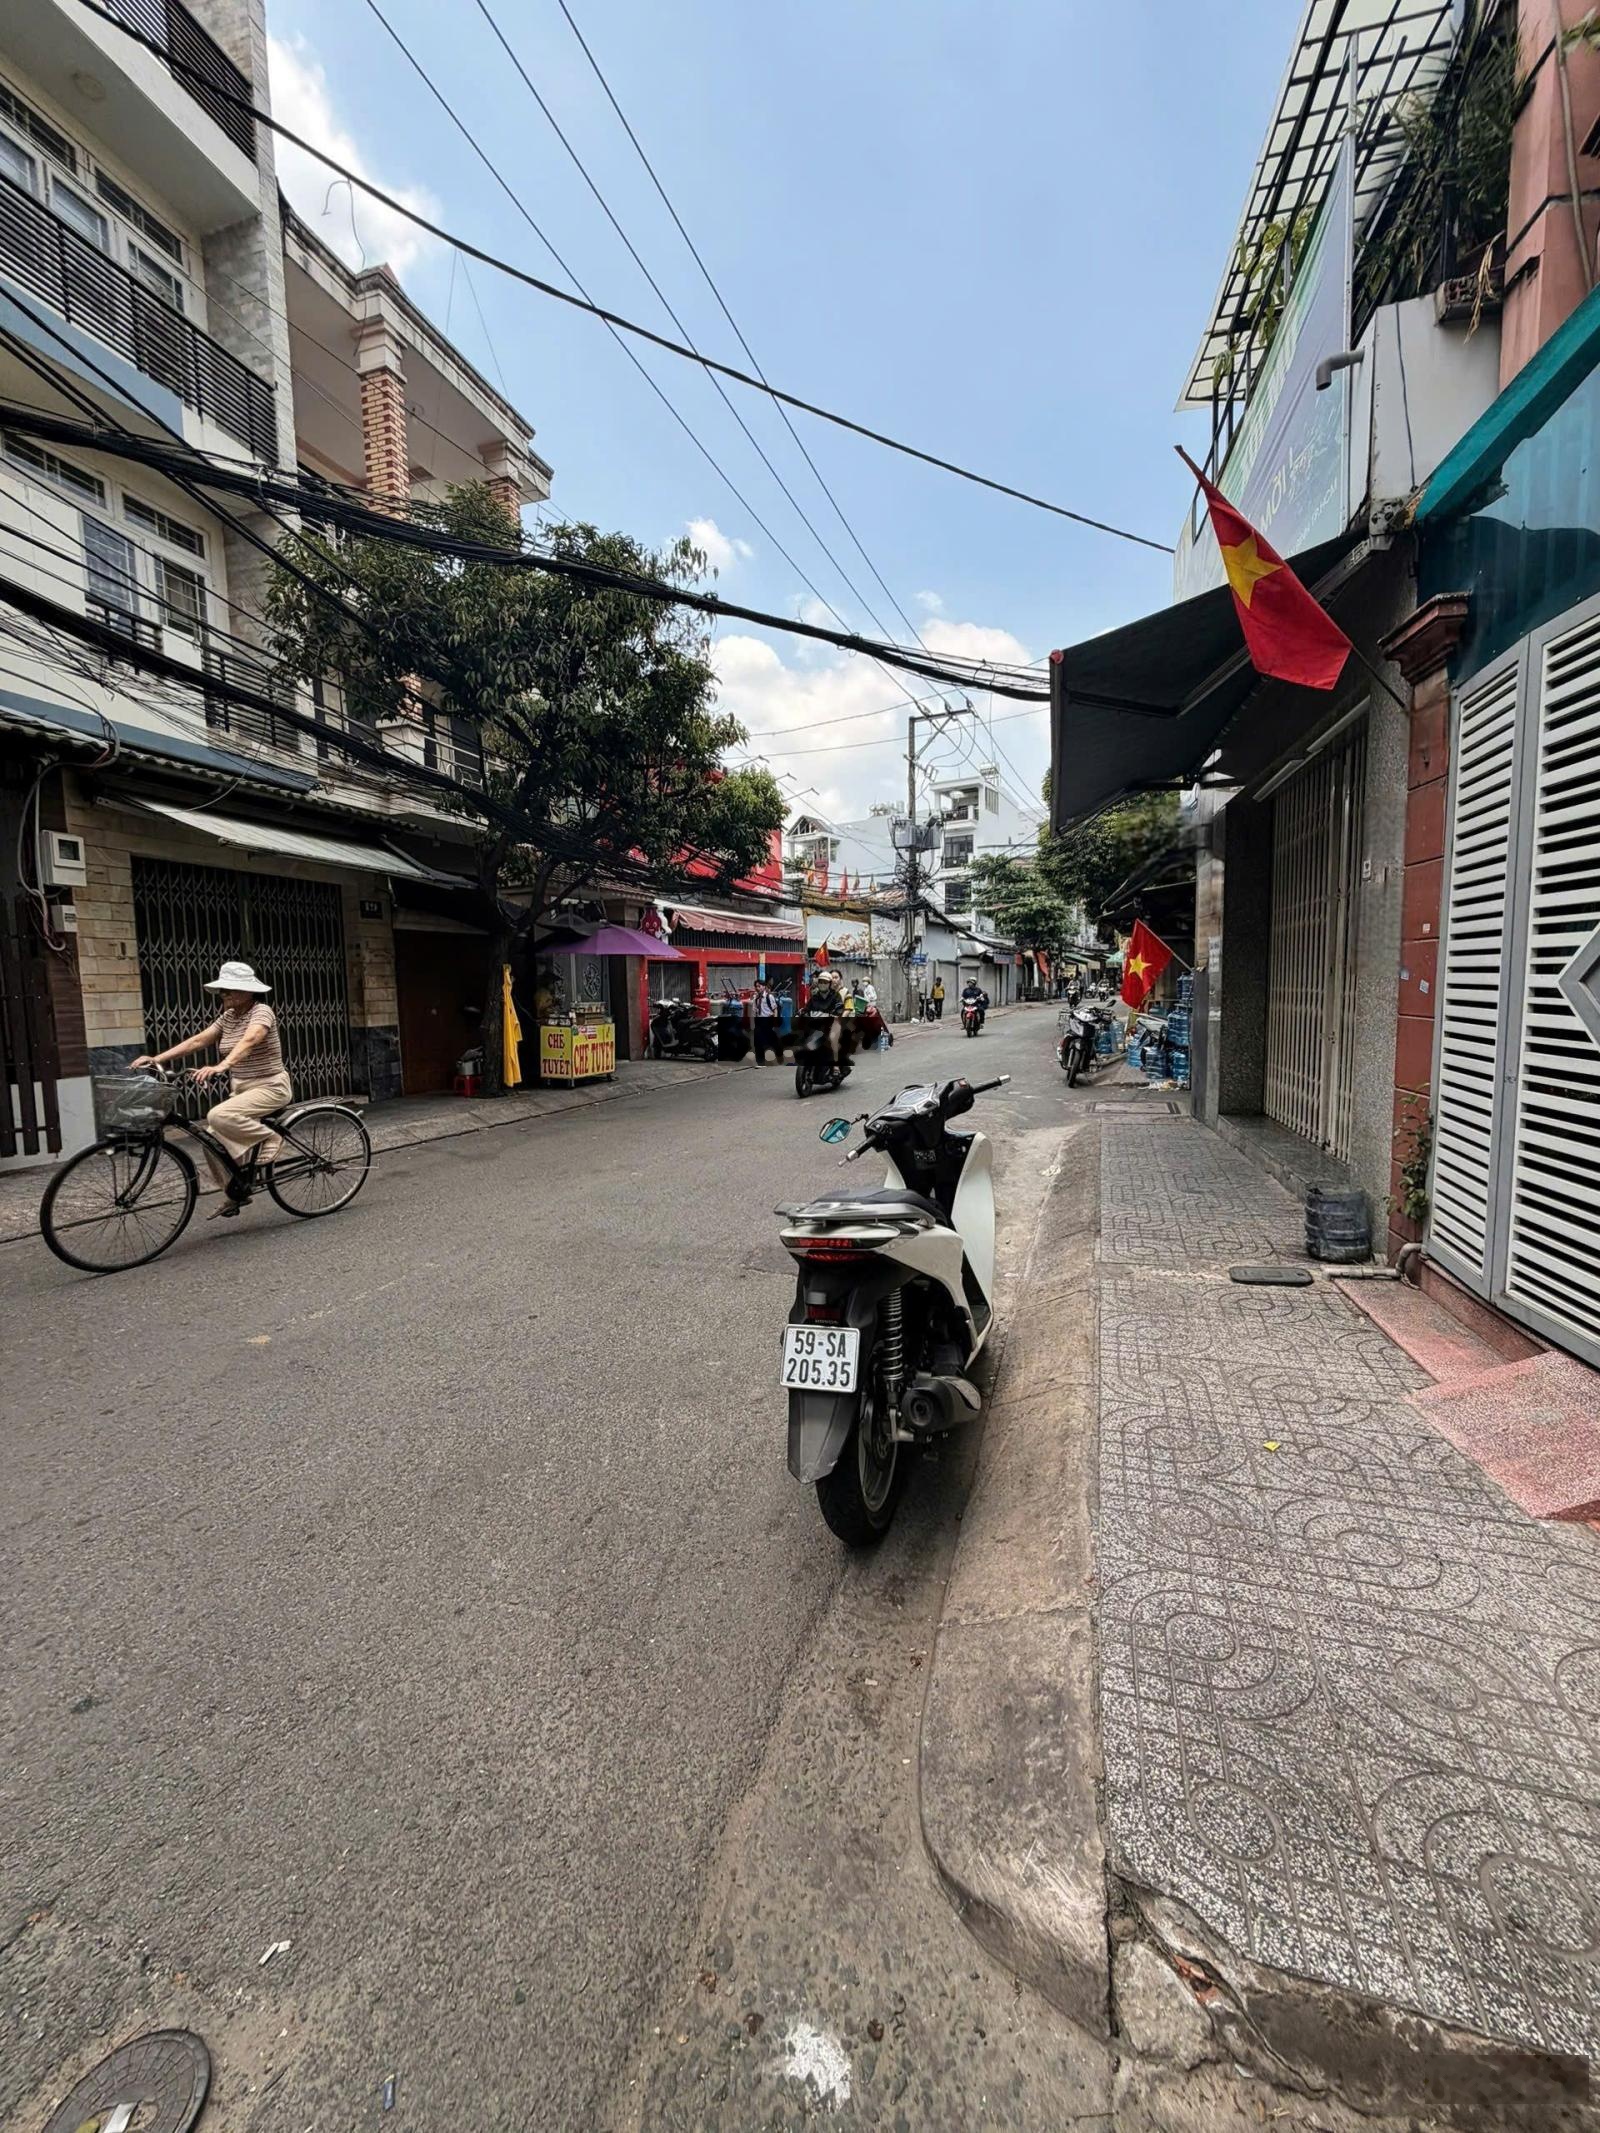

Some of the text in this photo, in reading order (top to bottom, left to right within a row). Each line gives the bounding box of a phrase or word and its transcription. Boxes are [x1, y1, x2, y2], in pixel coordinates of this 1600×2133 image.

[542, 1052, 570, 1075] TUYẾT
[794, 1330, 846, 1358] 59-SA
[786, 1357, 851, 1387] 205.35
